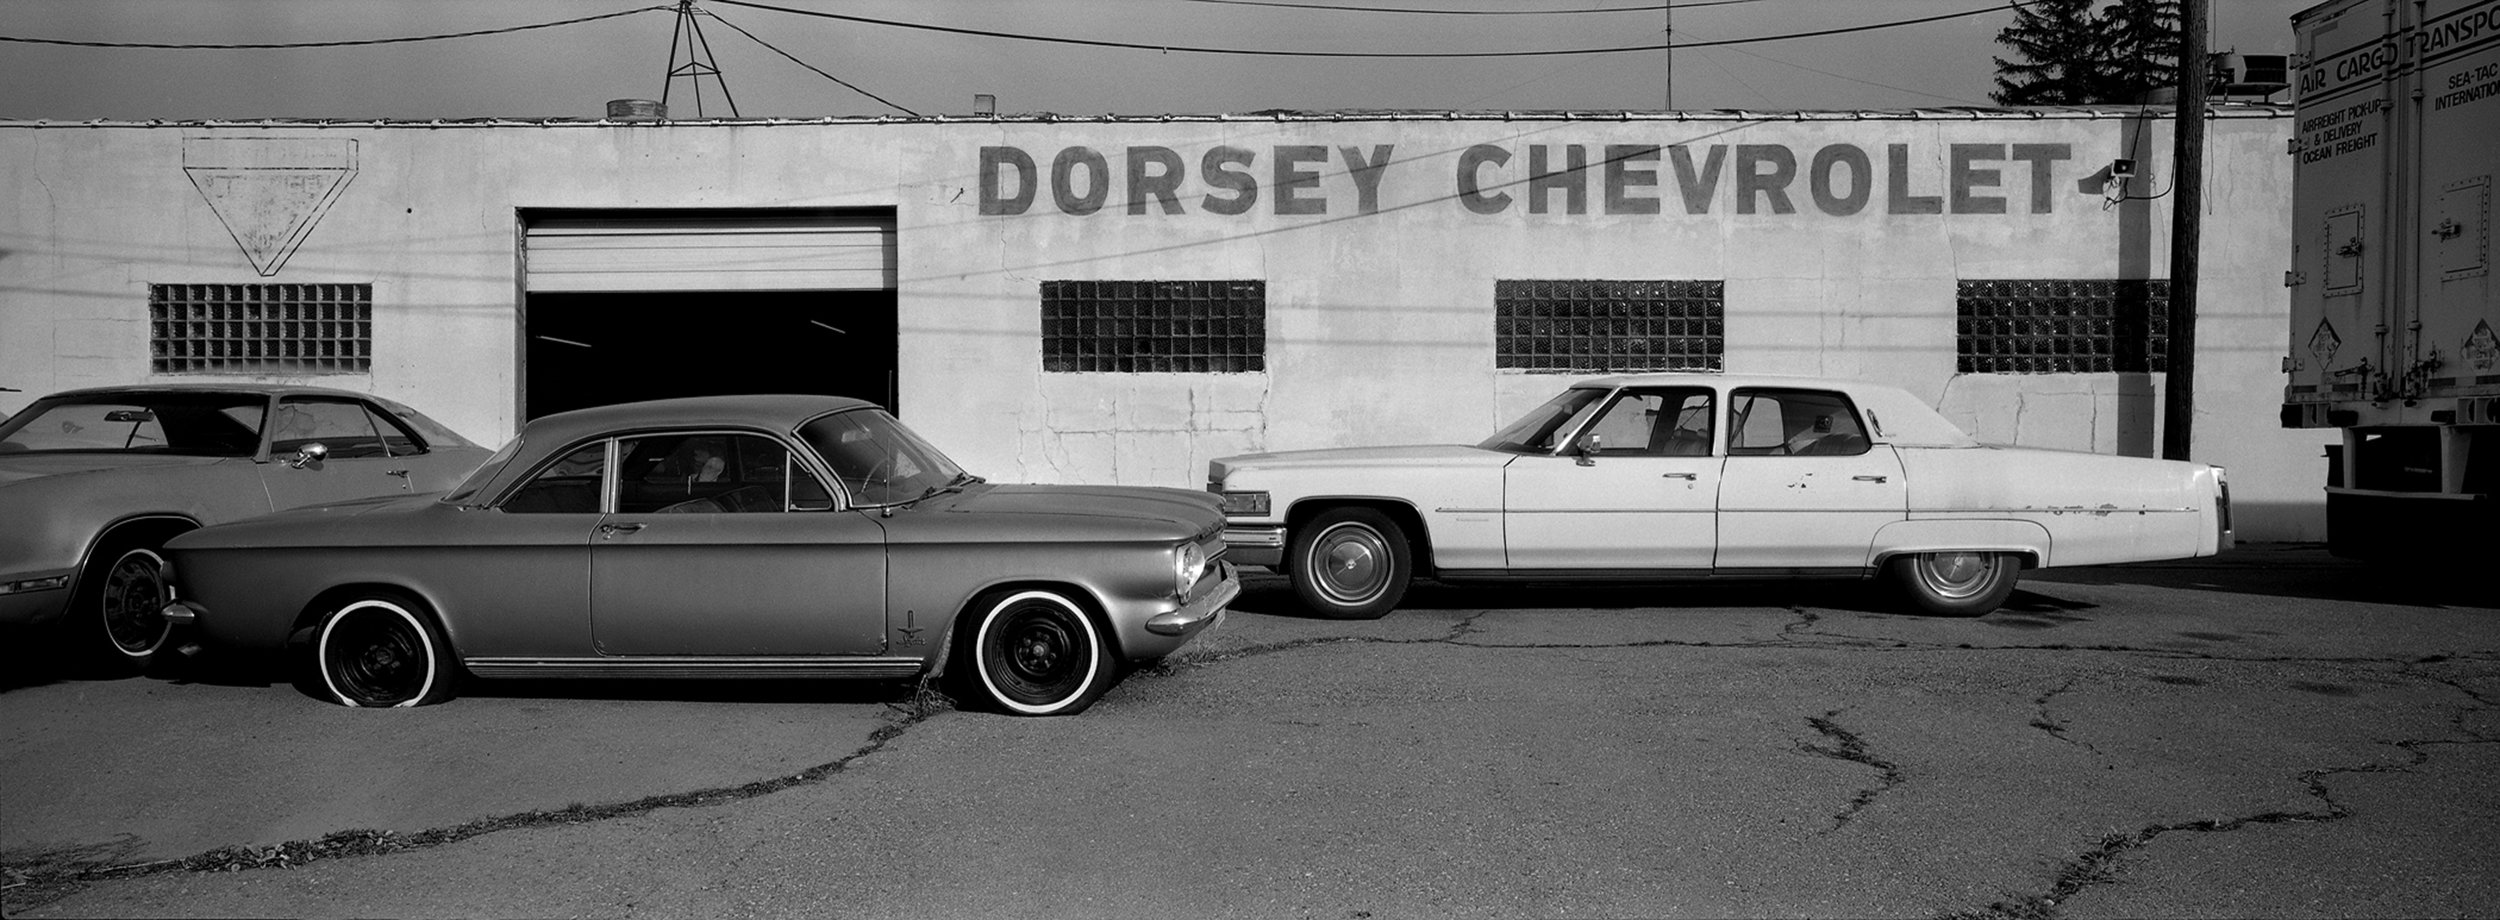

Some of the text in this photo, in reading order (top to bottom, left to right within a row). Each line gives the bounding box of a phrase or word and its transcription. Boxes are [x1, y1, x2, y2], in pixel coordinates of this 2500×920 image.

[2299, 68, 2327, 95] AIR
[2336, 43, 2398, 82] CARGO
[2448, 62, 2498, 90] SEA-TAC
[2435, 80, 2500, 111] INTERNATIO
[2302, 98, 2382, 134] AIRFREIGHT PICK-UP
[2303, 132, 2378, 165] OCEAN FREIGHT
[2314, 120, 2362, 146] & DELIVERY
[979, 143, 2071, 216] DORSEY CHEVROLET
